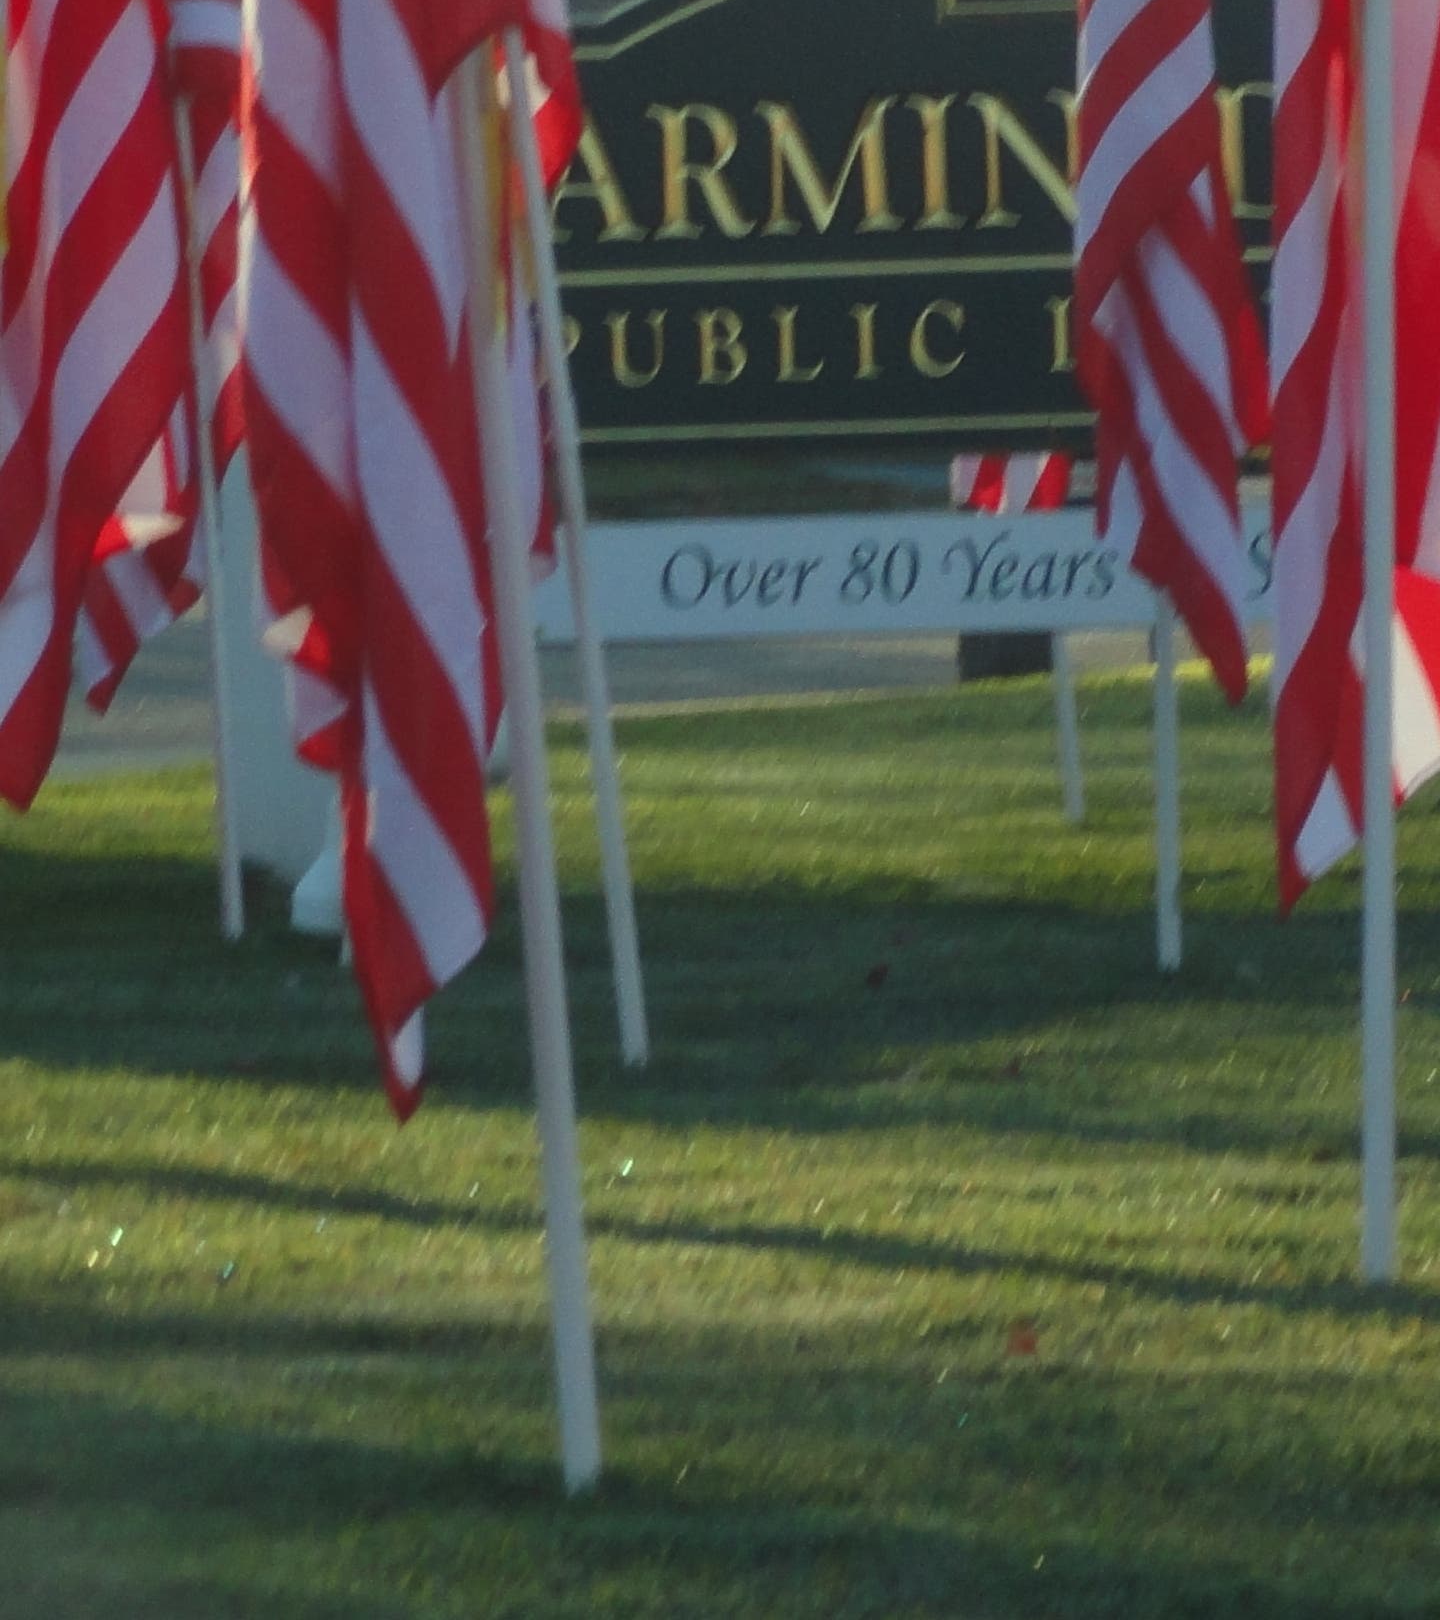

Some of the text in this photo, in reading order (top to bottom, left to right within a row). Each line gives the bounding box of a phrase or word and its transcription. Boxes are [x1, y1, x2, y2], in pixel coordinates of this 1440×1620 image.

[660, 530, 1119, 611] Over 80 Years
